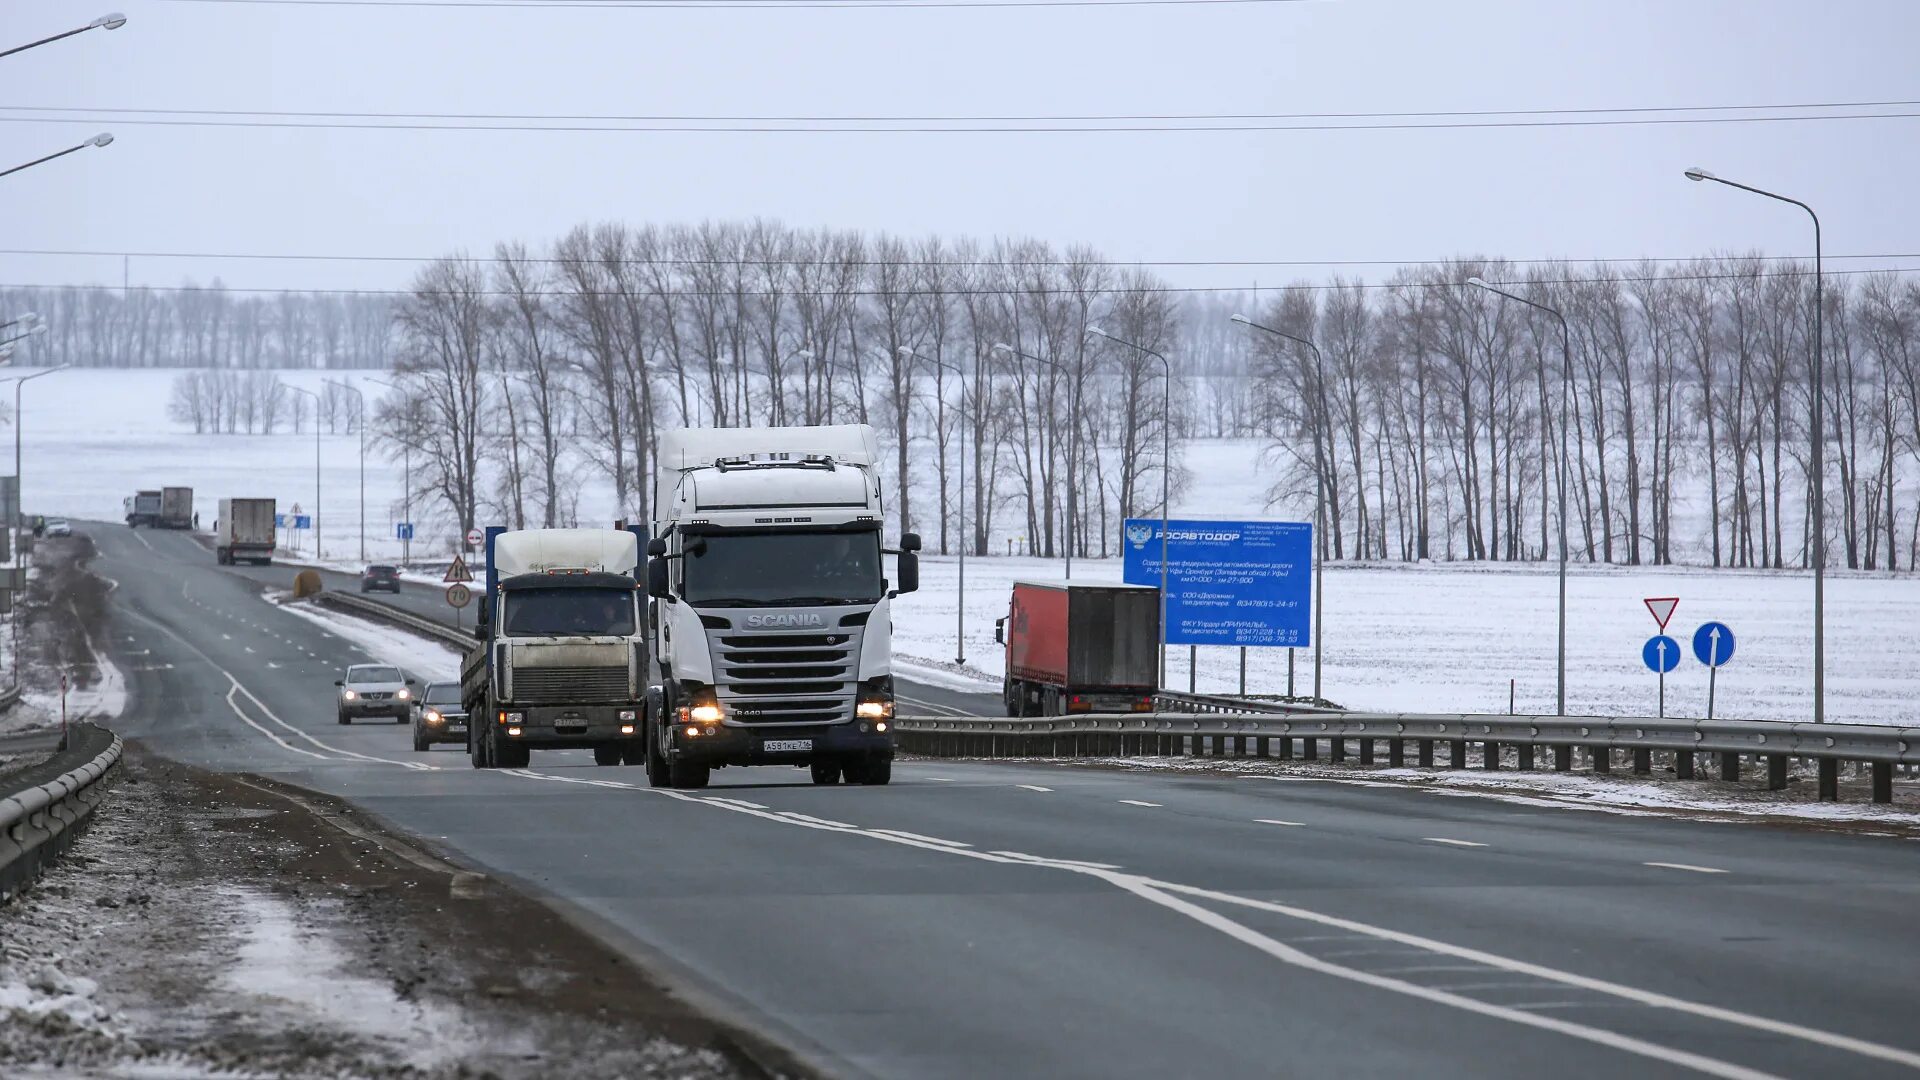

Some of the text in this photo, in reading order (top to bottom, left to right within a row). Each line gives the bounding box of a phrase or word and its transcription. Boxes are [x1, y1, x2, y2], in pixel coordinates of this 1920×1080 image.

[1181, 560, 1222, 568] федеральной
[1223, 561, 1271, 569] автомобильной
[1271, 562, 1292, 570] дороги
[452, 590, 466, 601] 70
[746, 613, 823, 628] SCANIA
